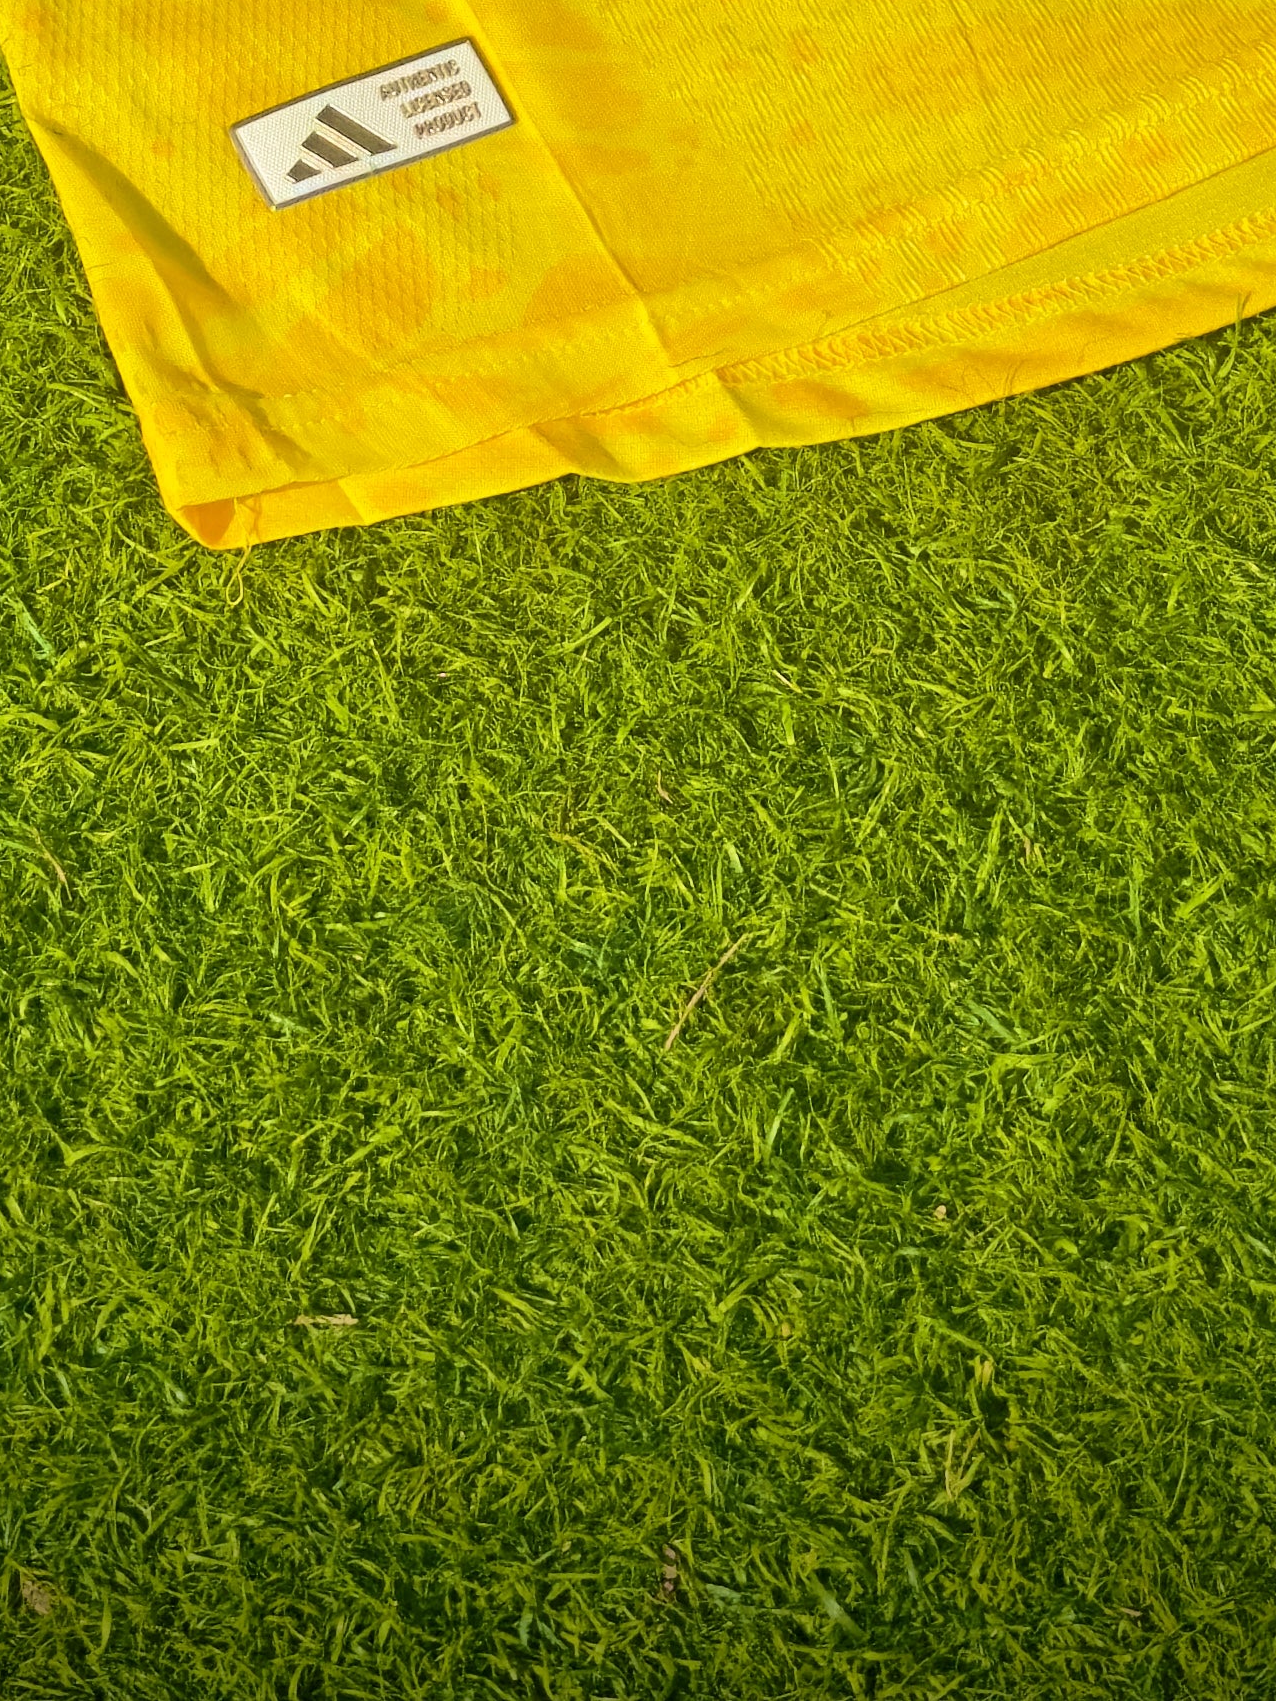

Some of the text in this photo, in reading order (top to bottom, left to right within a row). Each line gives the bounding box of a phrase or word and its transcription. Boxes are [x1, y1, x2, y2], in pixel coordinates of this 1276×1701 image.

[380, 59, 461, 101] AUTHENTIC
[400, 80, 472, 119] LICENSED
[413, 101, 482, 140] PRODUCT
